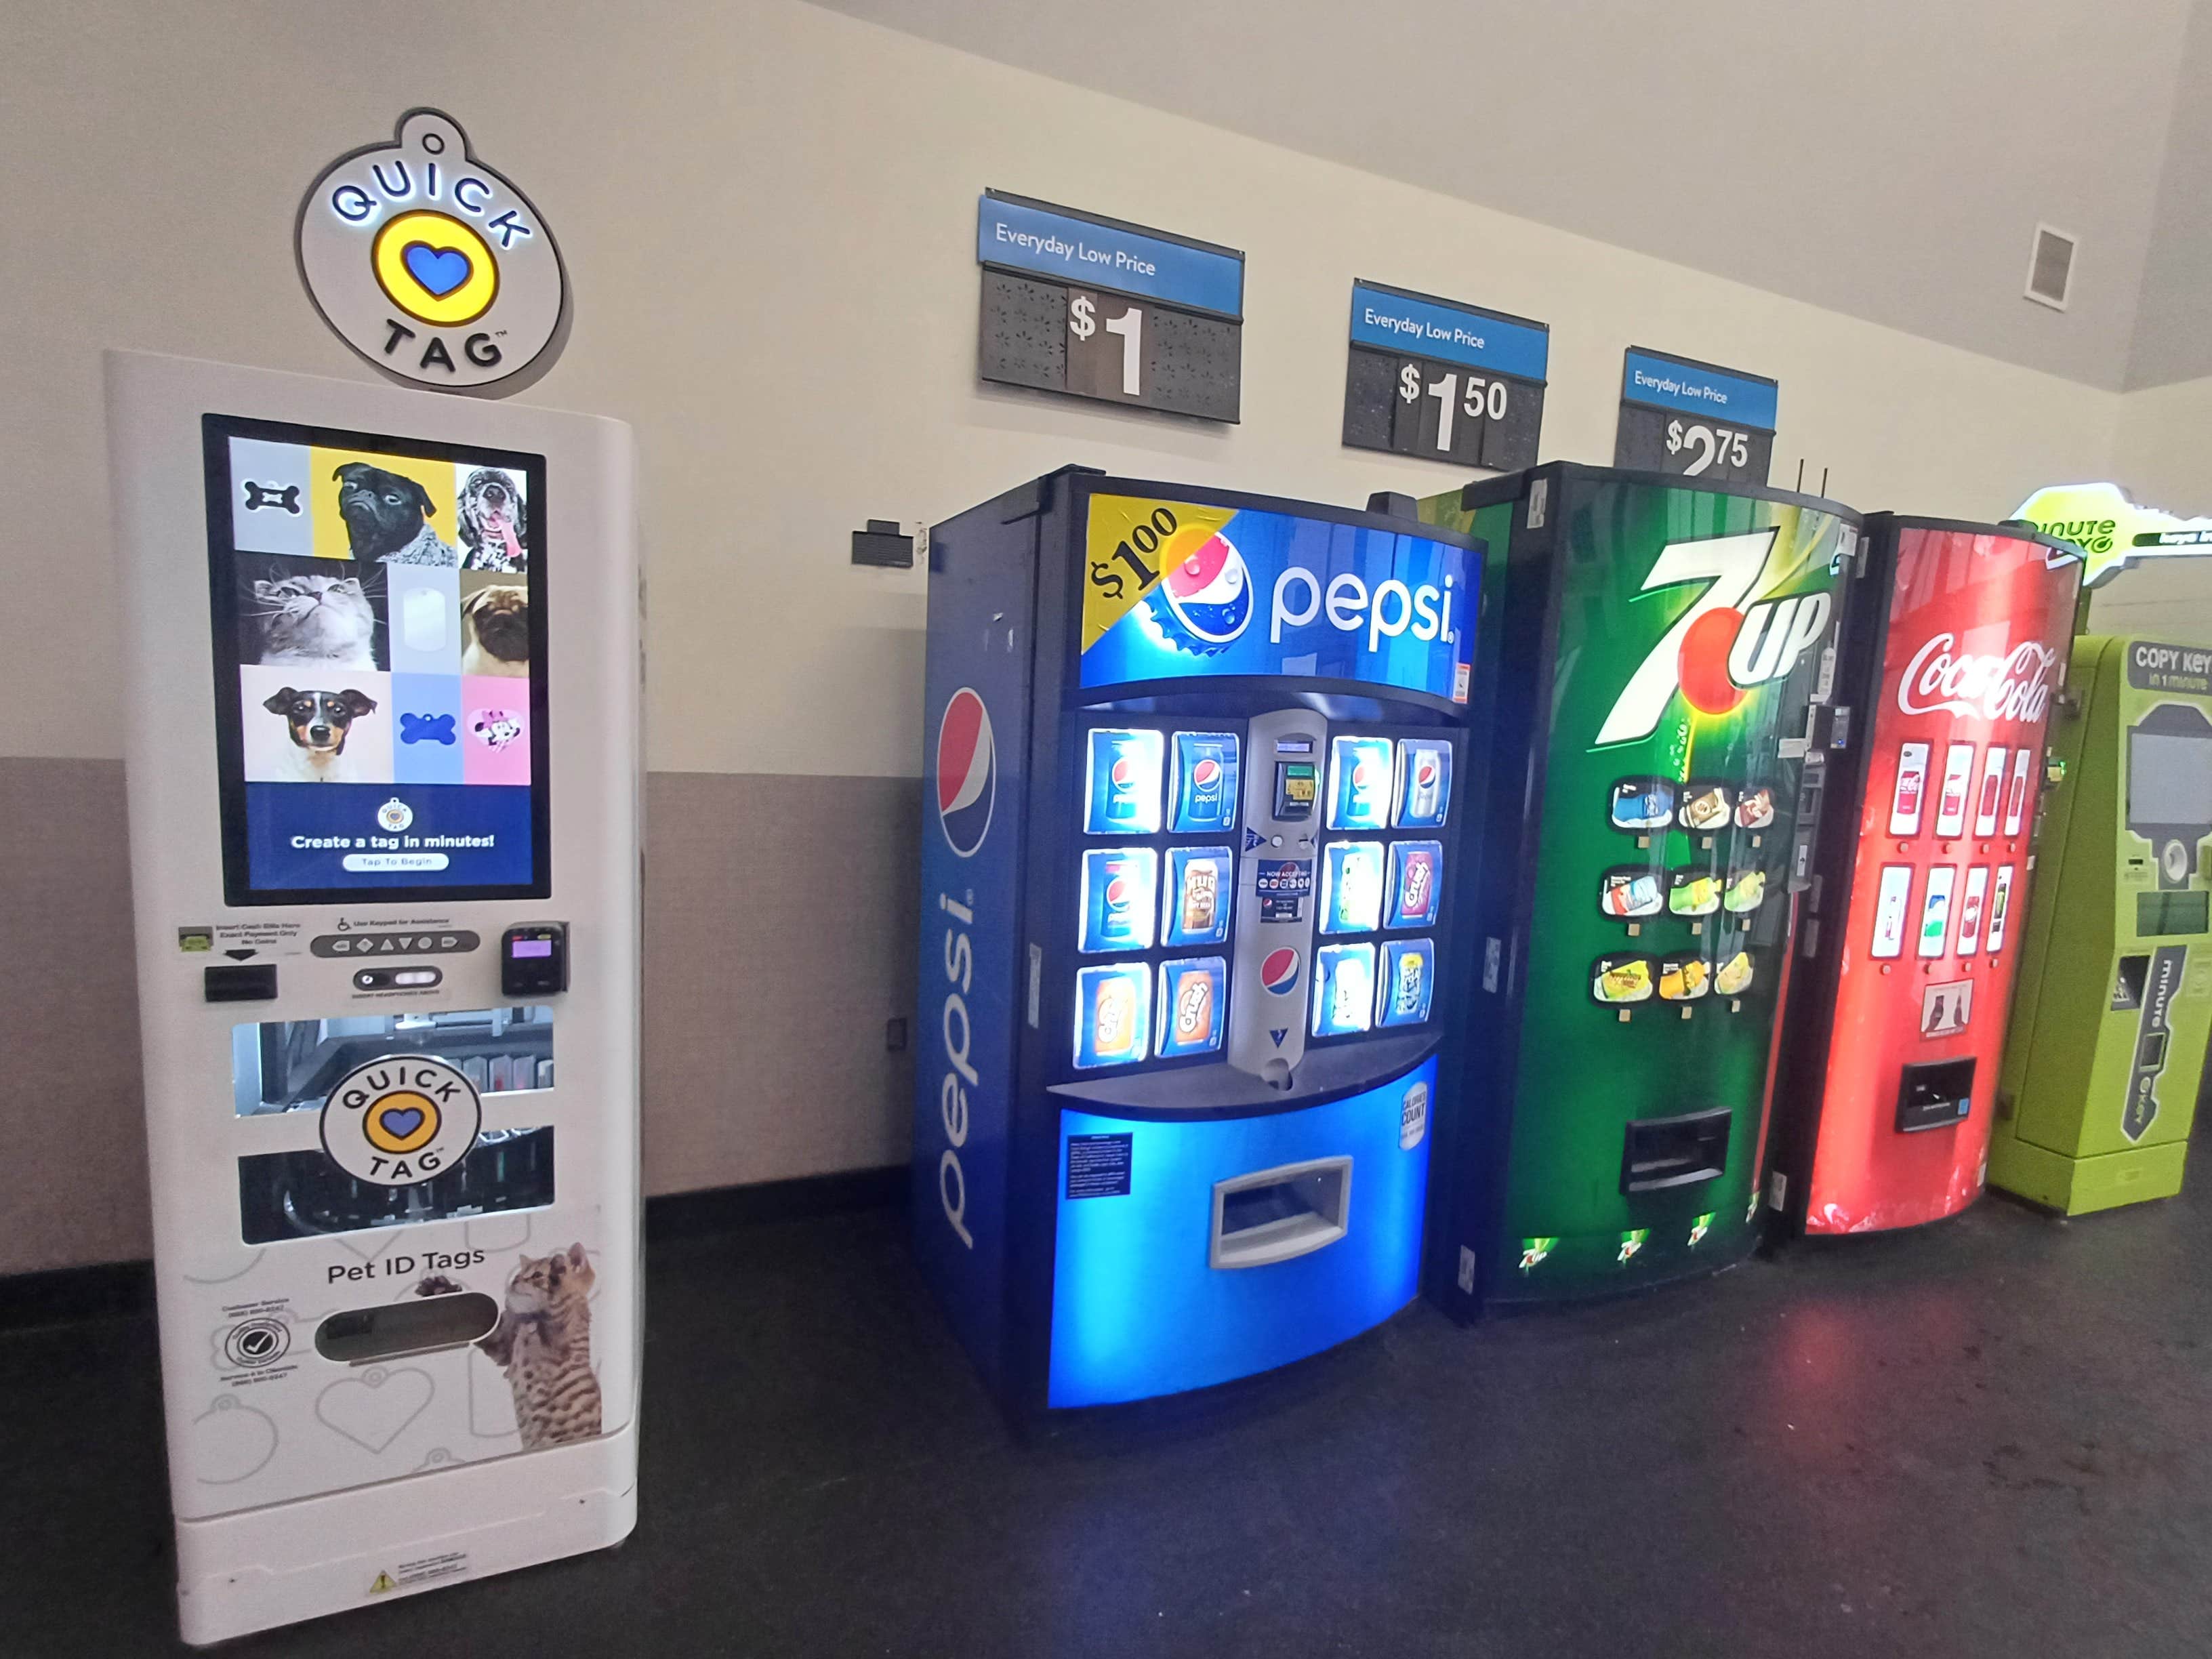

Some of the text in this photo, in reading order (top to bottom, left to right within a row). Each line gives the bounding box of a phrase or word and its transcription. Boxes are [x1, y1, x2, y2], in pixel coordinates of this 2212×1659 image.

[332, 161, 530, 247] QUICK
[996, 224, 1155, 276] Everyday Low Price
[1364, 307, 1485, 349] Everyday Low Price
[384, 319, 502, 373] TAG
[1635, 370, 1727, 405] Everyday Low Price
[1270, 567, 1453, 653] pepsi
[2136, 646, 2179, 671] COPY
[2162, 674, 2167, 687] 1
[1195, 794, 1218, 803] pepsi
[291, 834, 494, 850] Create a tag in minutes!
[362, 858, 381, 867] Tap
[401, 857, 432, 867] Begin
[342, 1067, 462, 1110] QUICK
[939, 892, 979, 1250] pepsi
[369, 1151, 442, 1180] TAG
[327, 1249, 486, 1284] Pet ID Tags
